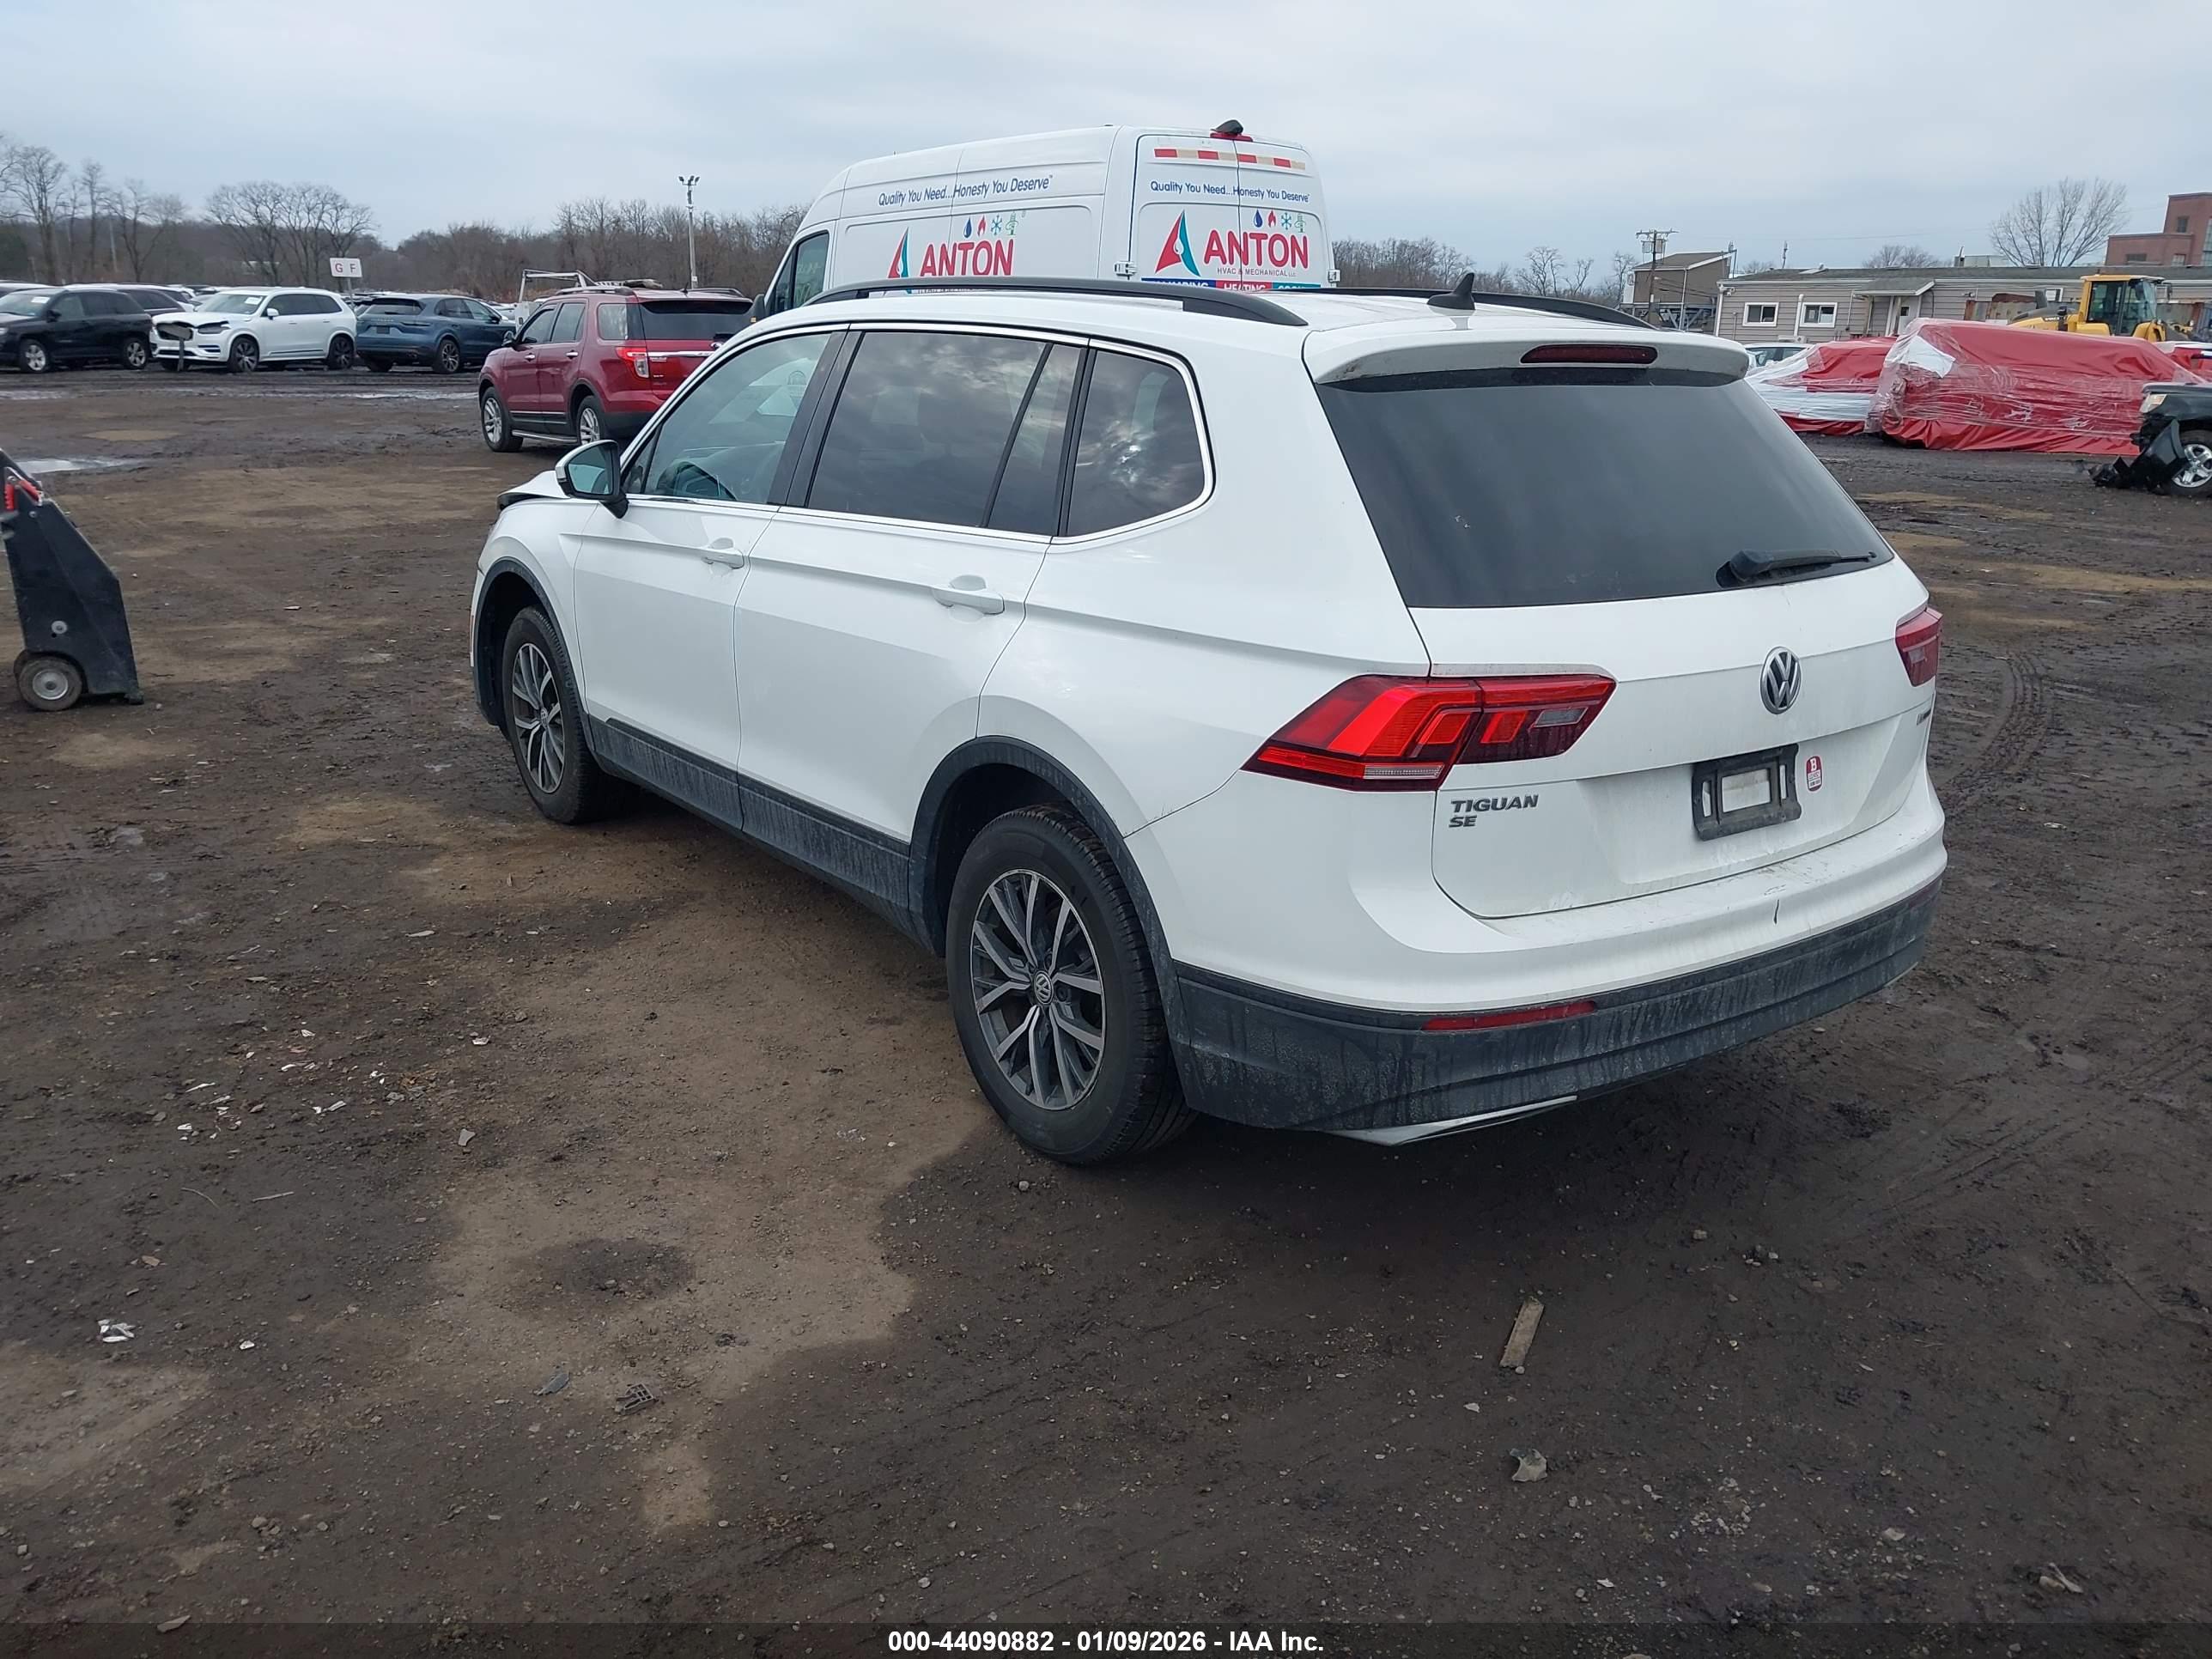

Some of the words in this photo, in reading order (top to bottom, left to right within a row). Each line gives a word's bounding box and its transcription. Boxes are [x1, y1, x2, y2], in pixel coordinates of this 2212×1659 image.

[878, 191, 905, 207] Quality
[908, 189, 922, 203] You
[991, 179, 1008, 194] You
[1150, 180, 1182, 194] Quality
[1185, 182, 1201, 193] You
[1266, 188, 1279, 200] You
[920, 239, 1014, 277] ANTON
[1204, 229, 1309, 269] ANTON
[335, 263, 343, 273] G
[349, 263, 356, 273] F
[1245, 268, 1288, 276] MECHANICAL
[1809, 757, 1818, 772] B
[1451, 793, 1539, 813] TIGUAN
[1449, 815, 1477, 829] SE
